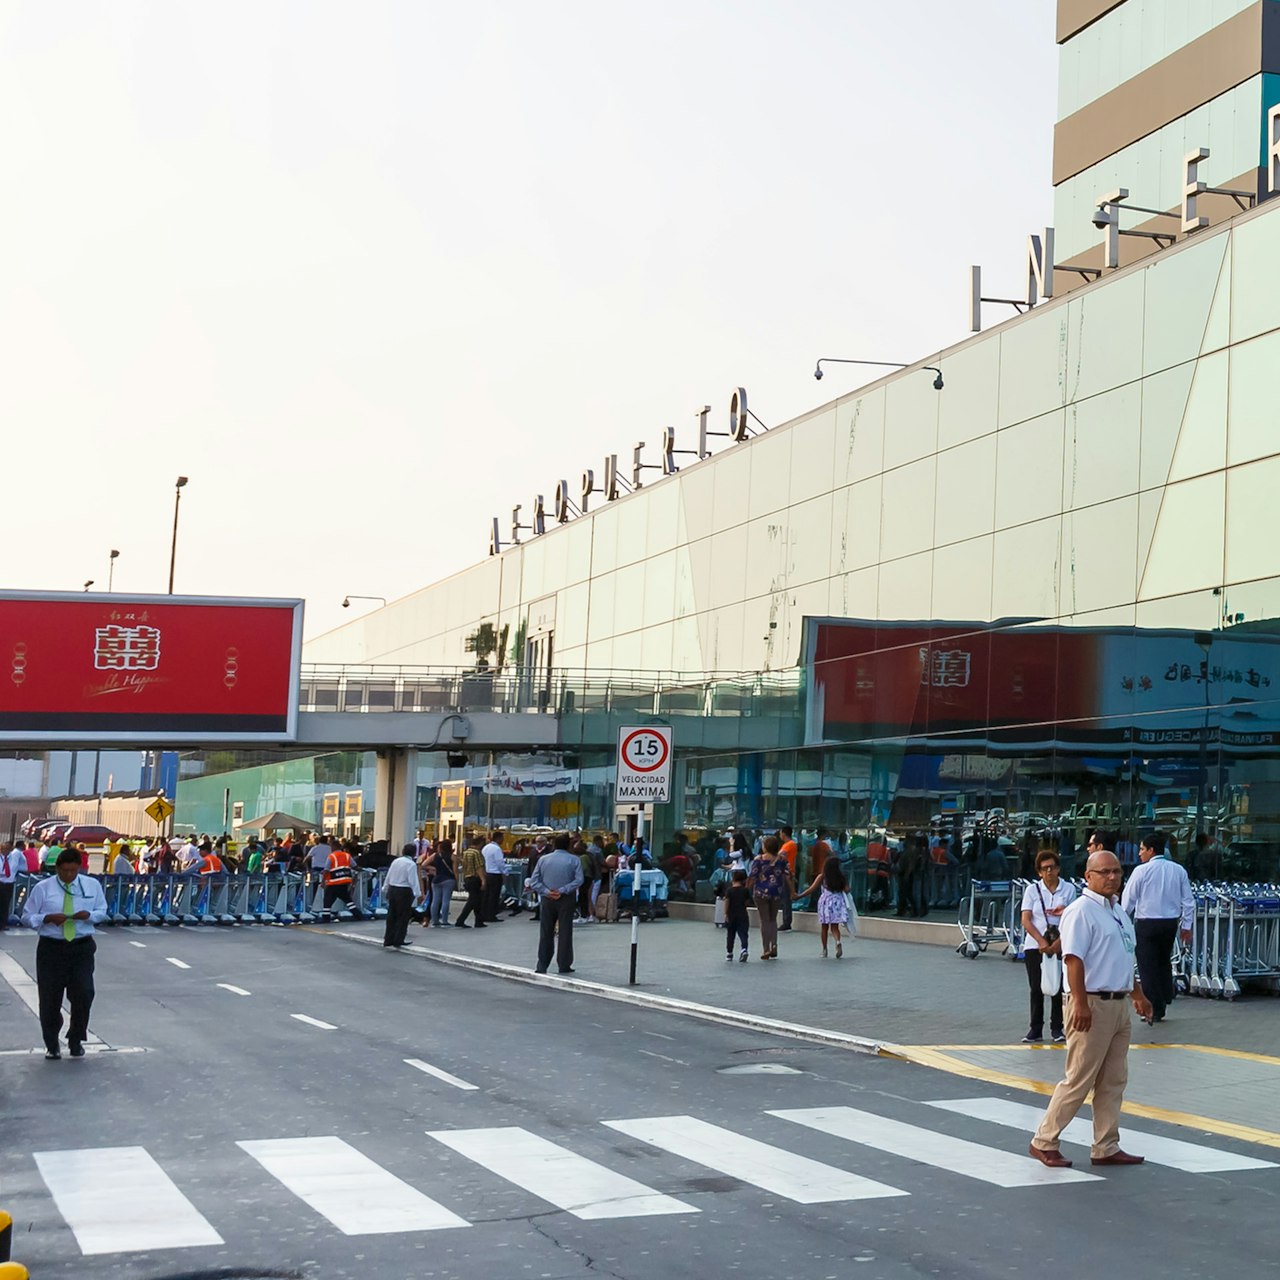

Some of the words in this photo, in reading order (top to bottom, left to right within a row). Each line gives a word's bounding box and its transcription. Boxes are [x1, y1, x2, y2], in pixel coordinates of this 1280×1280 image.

[489, 387, 749, 556] AEROPUERTO
[634, 739, 659, 756] 15
[622, 775, 665, 783] VELOCIDAD
[619, 786, 666, 797] MAXIMA
